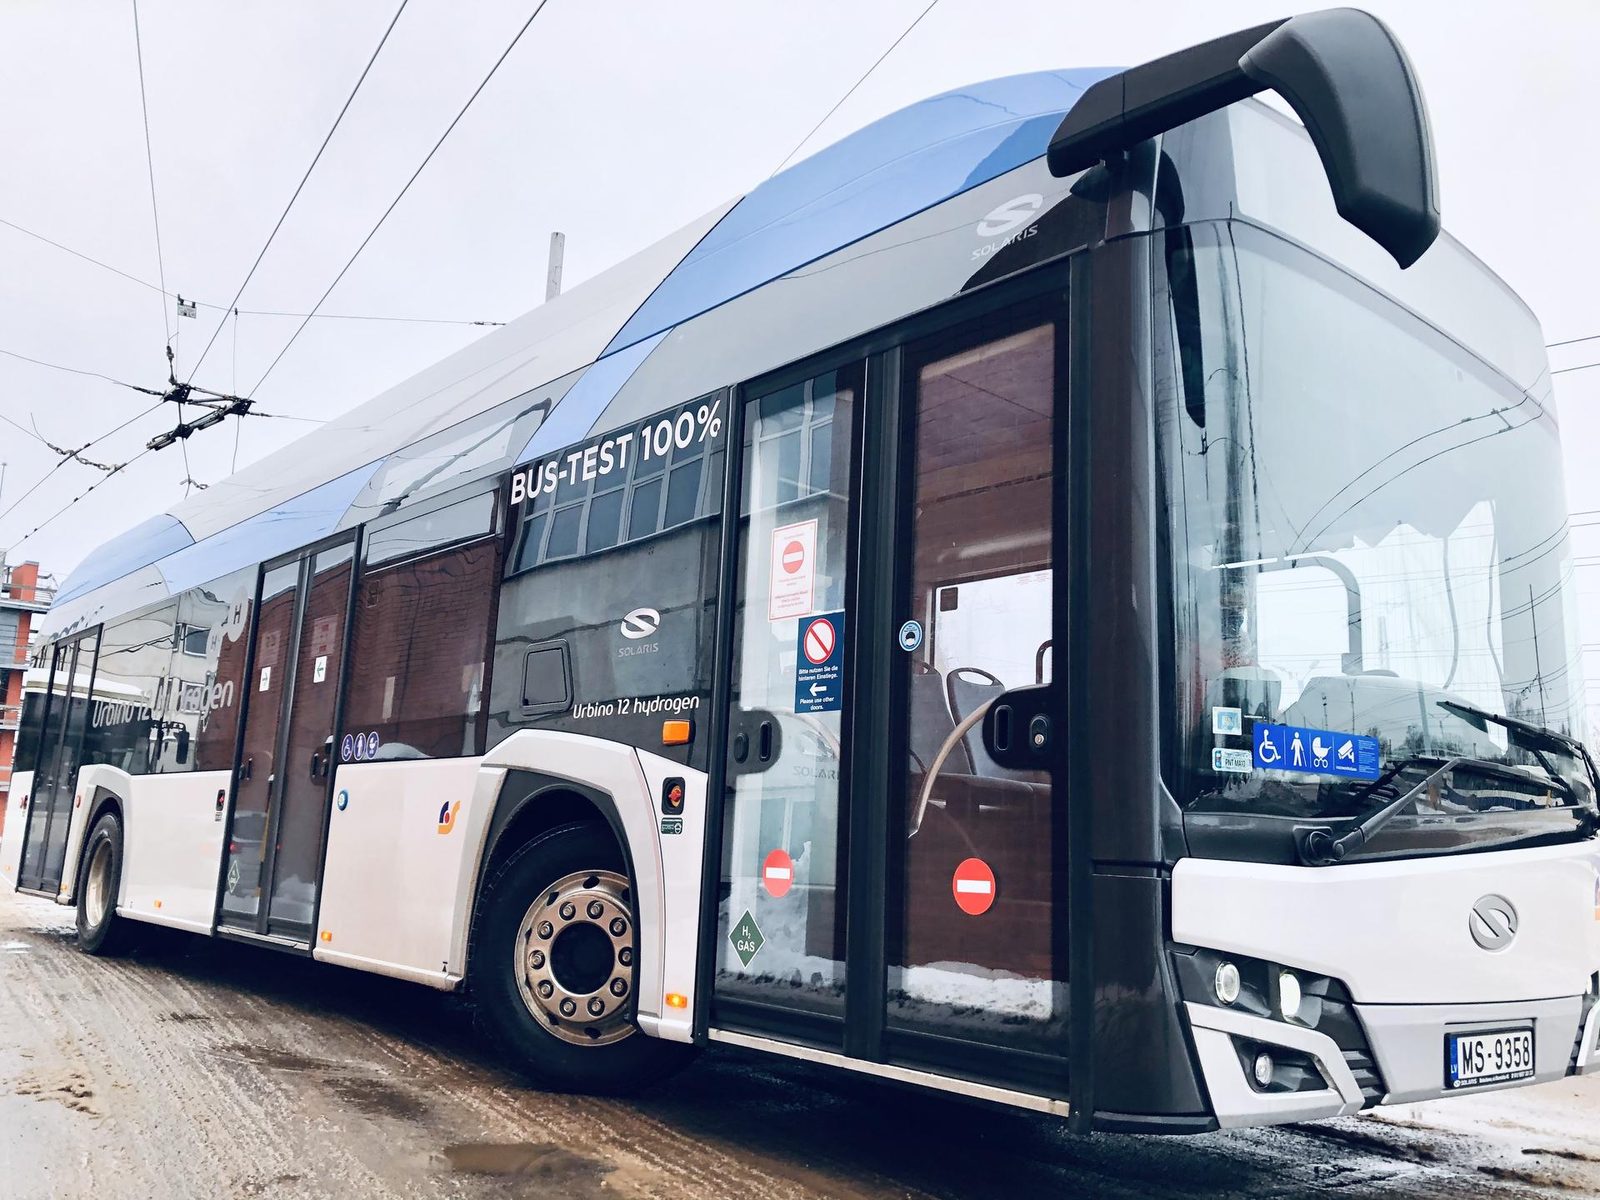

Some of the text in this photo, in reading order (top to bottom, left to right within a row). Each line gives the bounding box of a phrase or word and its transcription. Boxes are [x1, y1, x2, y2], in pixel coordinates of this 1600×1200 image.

[970, 224, 1039, 261] SOLARIS
[510, 400, 722, 505] BUS-TEST 100%
[618, 643, 659, 658] SOLARIS
[573, 695, 700, 719] Urbino 12 hydrogen
[792, 765, 840, 780] SOLAR
[737, 940, 755, 952] GAS
[1462, 1036, 1530, 1075] MS-9358
[1450, 1063, 1458, 1074] LV
